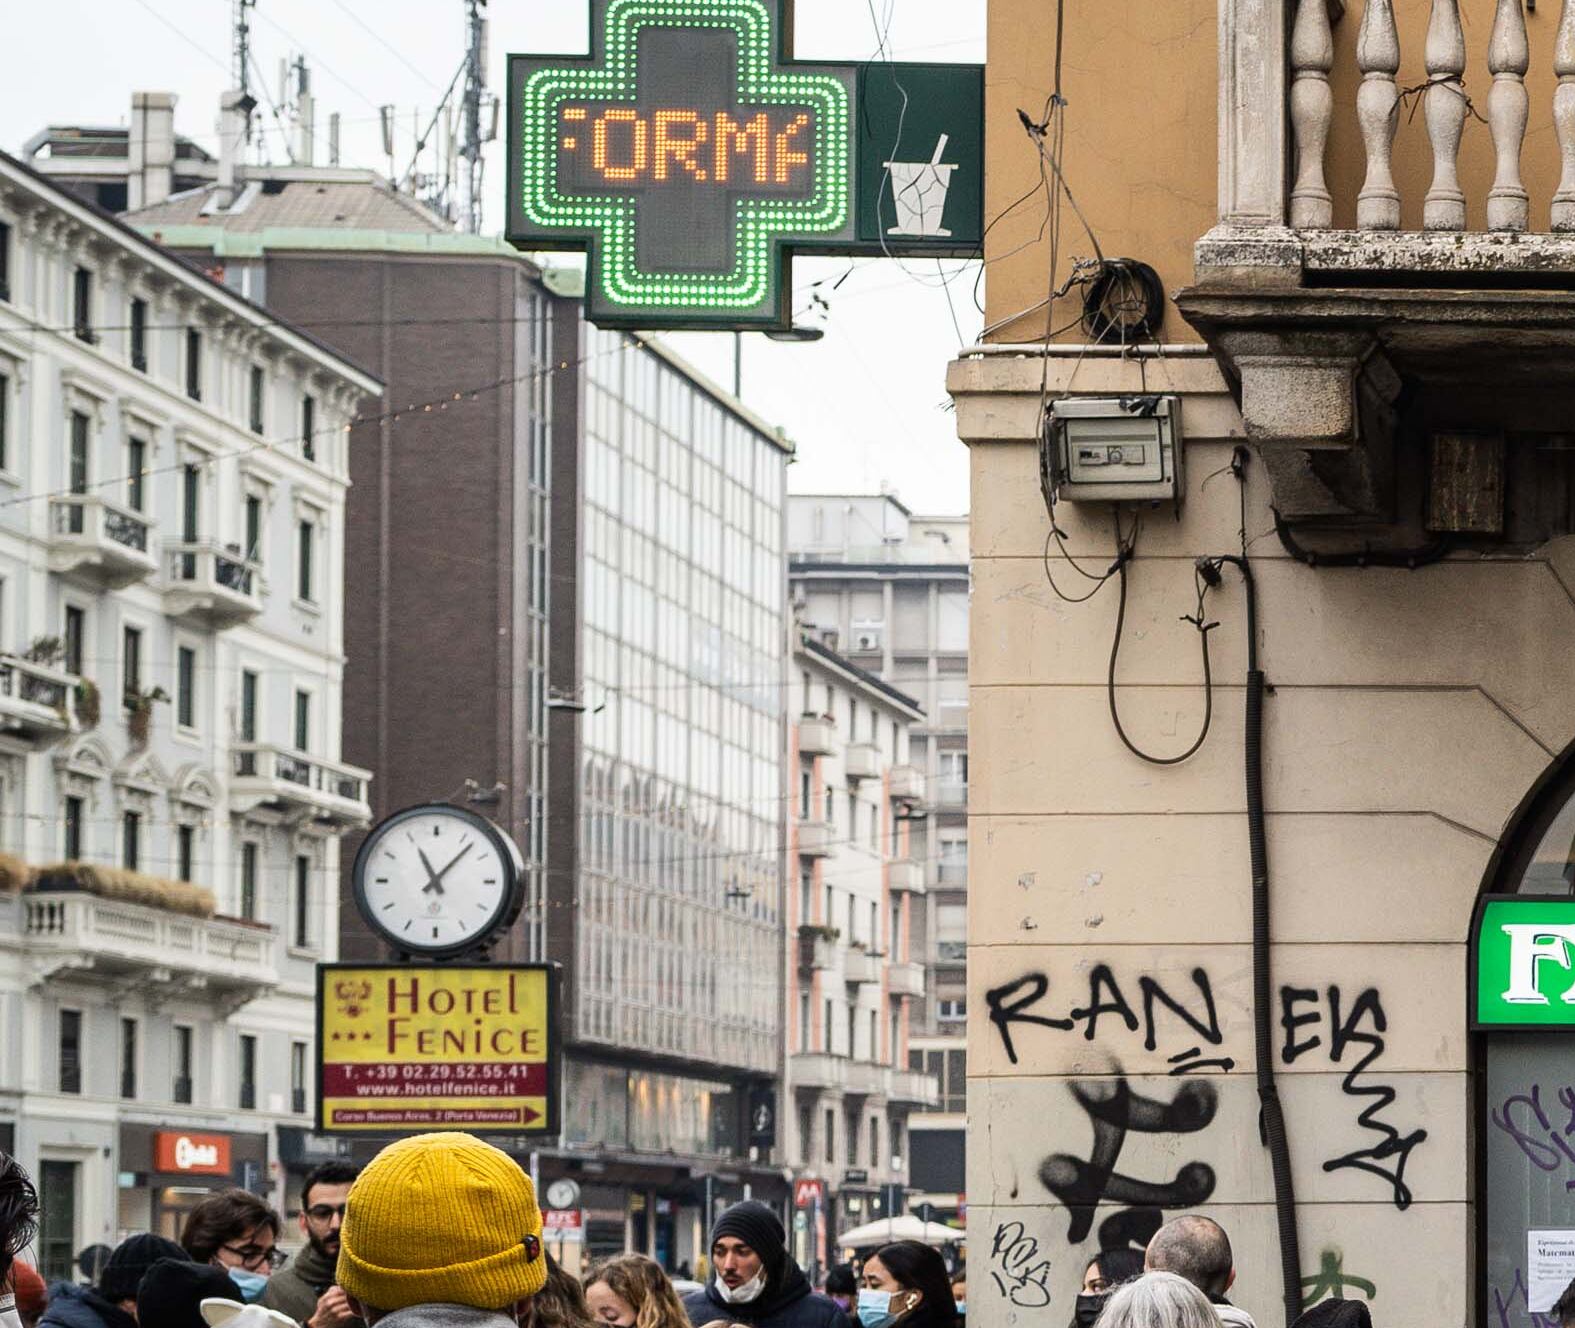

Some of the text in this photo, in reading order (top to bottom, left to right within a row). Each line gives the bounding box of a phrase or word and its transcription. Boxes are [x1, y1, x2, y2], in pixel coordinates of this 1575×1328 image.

[343, 1065, 529, 1080] T. +39 02.29.52.55.41
[356, 1082, 517, 1095] www.hotelfenice.it
[334, 1110, 365, 1122] Corso
[366, 1110, 401, 1122] Buenos
[444, 1110, 474, 1123] (Porta
[475, 1110, 518, 1123] Venezia)
